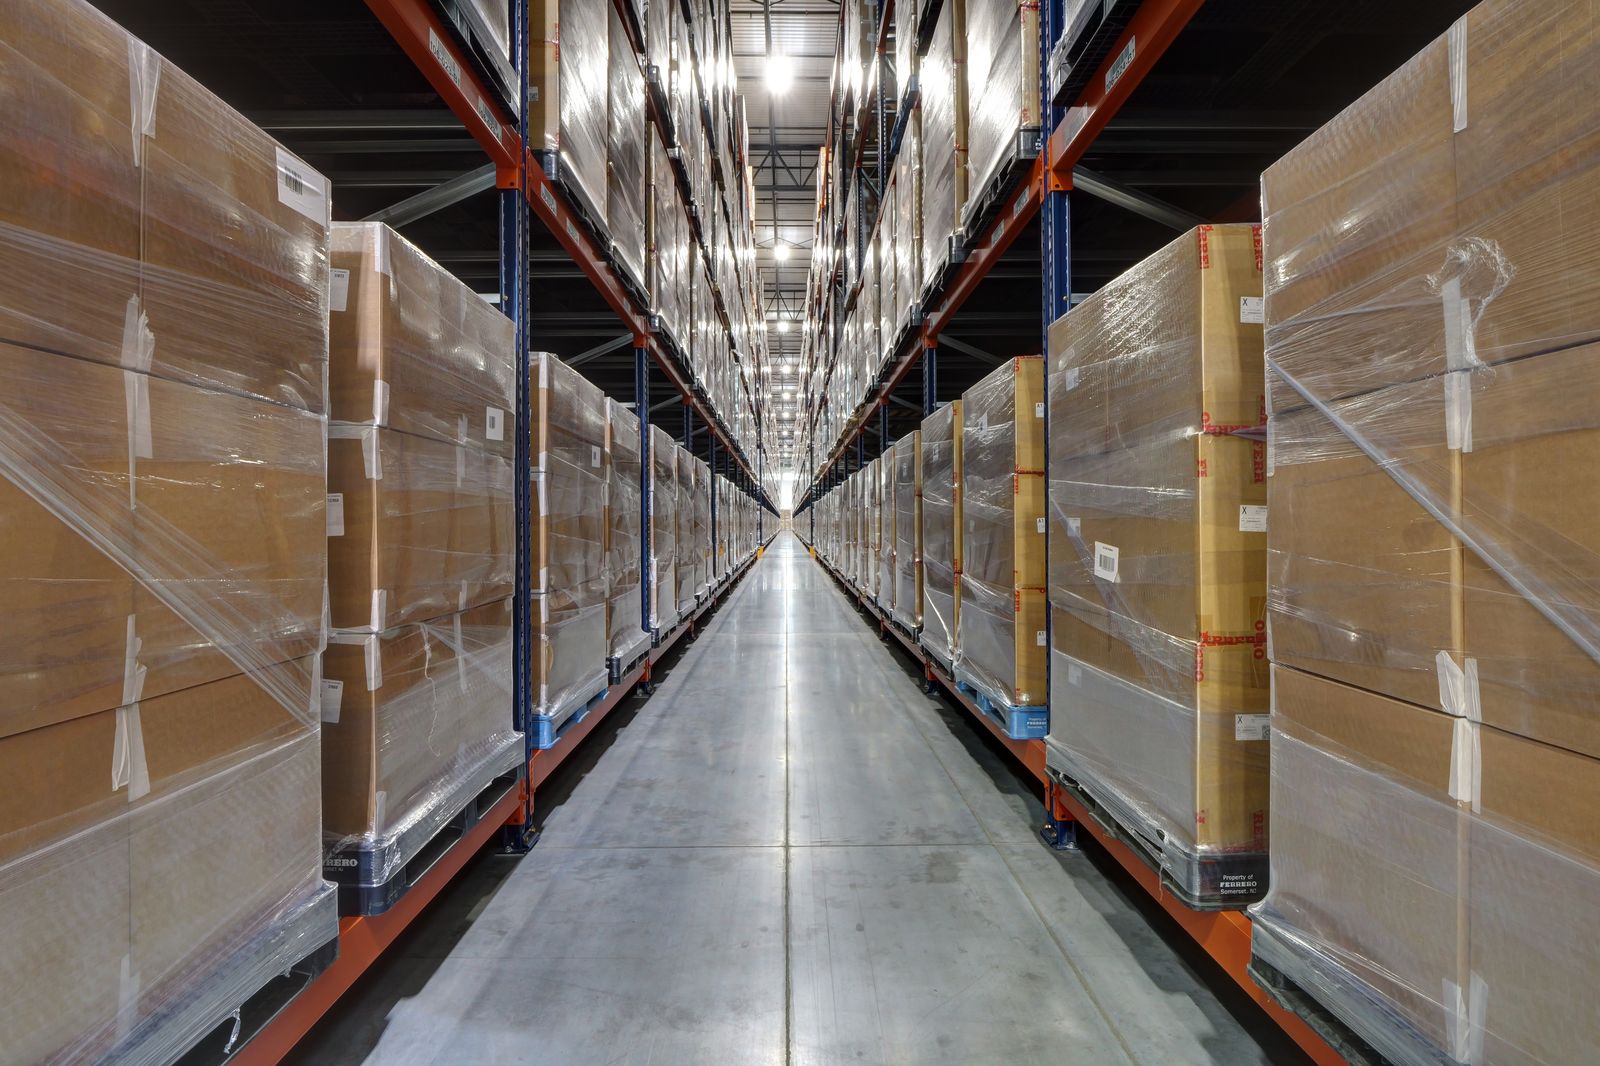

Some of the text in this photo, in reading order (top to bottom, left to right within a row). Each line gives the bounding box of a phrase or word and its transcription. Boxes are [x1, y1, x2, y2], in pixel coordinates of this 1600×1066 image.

[1242, 298, 1248, 306] X
[1241, 506, 1247, 515] X
[1237, 715, 1243, 724] X
